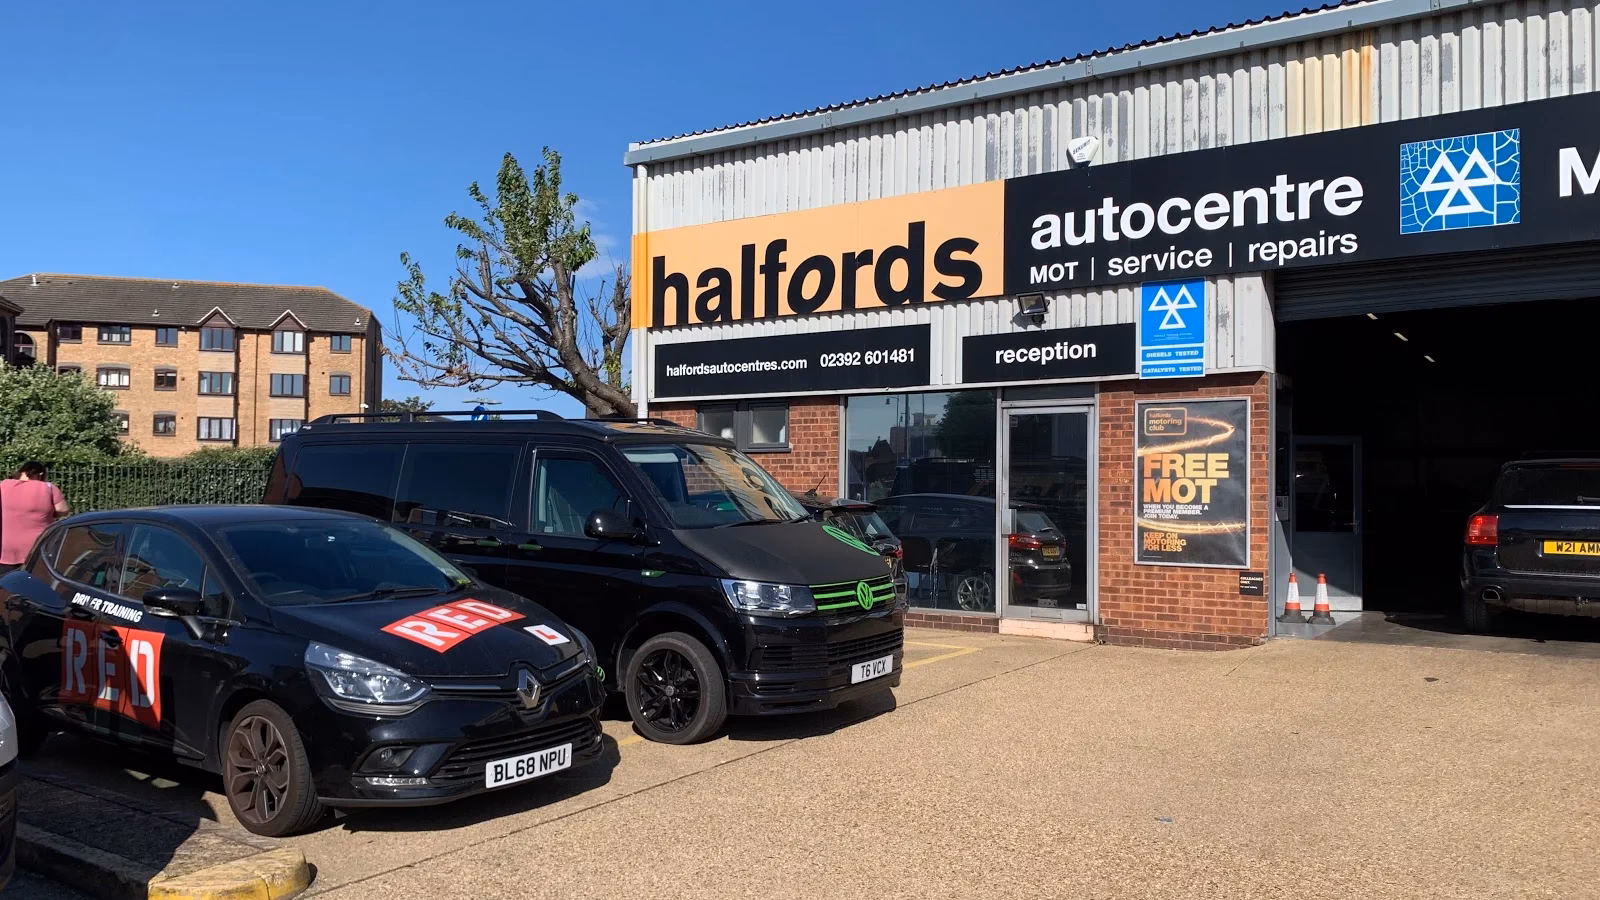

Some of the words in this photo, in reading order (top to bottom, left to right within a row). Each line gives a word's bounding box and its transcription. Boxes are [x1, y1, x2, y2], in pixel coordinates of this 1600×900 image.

[1030, 174, 1364, 250] autocentre
[1030, 261, 1079, 284] MOT
[1107, 245, 1213, 276] service
[1248, 230, 1358, 266] repairs
[652, 221, 983, 328] halfords
[666, 357, 808, 377] halfordsautocentres.com
[820, 352, 861, 368] 02392
[864, 348, 915, 365] 601481
[995, 341, 1097, 365] reception
[1149, 418, 1182, 426] motoring
[1143, 453, 1229, 478] FREE
[1143, 478, 1217, 503] MOT
[1143, 538, 1187, 546] MOTORING
[1165, 532, 1178, 540] ON
[1556, 542, 1576, 553] W21
[101, 600, 143, 623] TRAINING
[393, 601, 513, 647] RED
[65, 627, 155, 708] RED
[861, 664, 871, 679] T6
[872, 659, 886, 676] VCX
[493, 756, 536, 783] BL68
[540, 748, 566, 772] NPU
